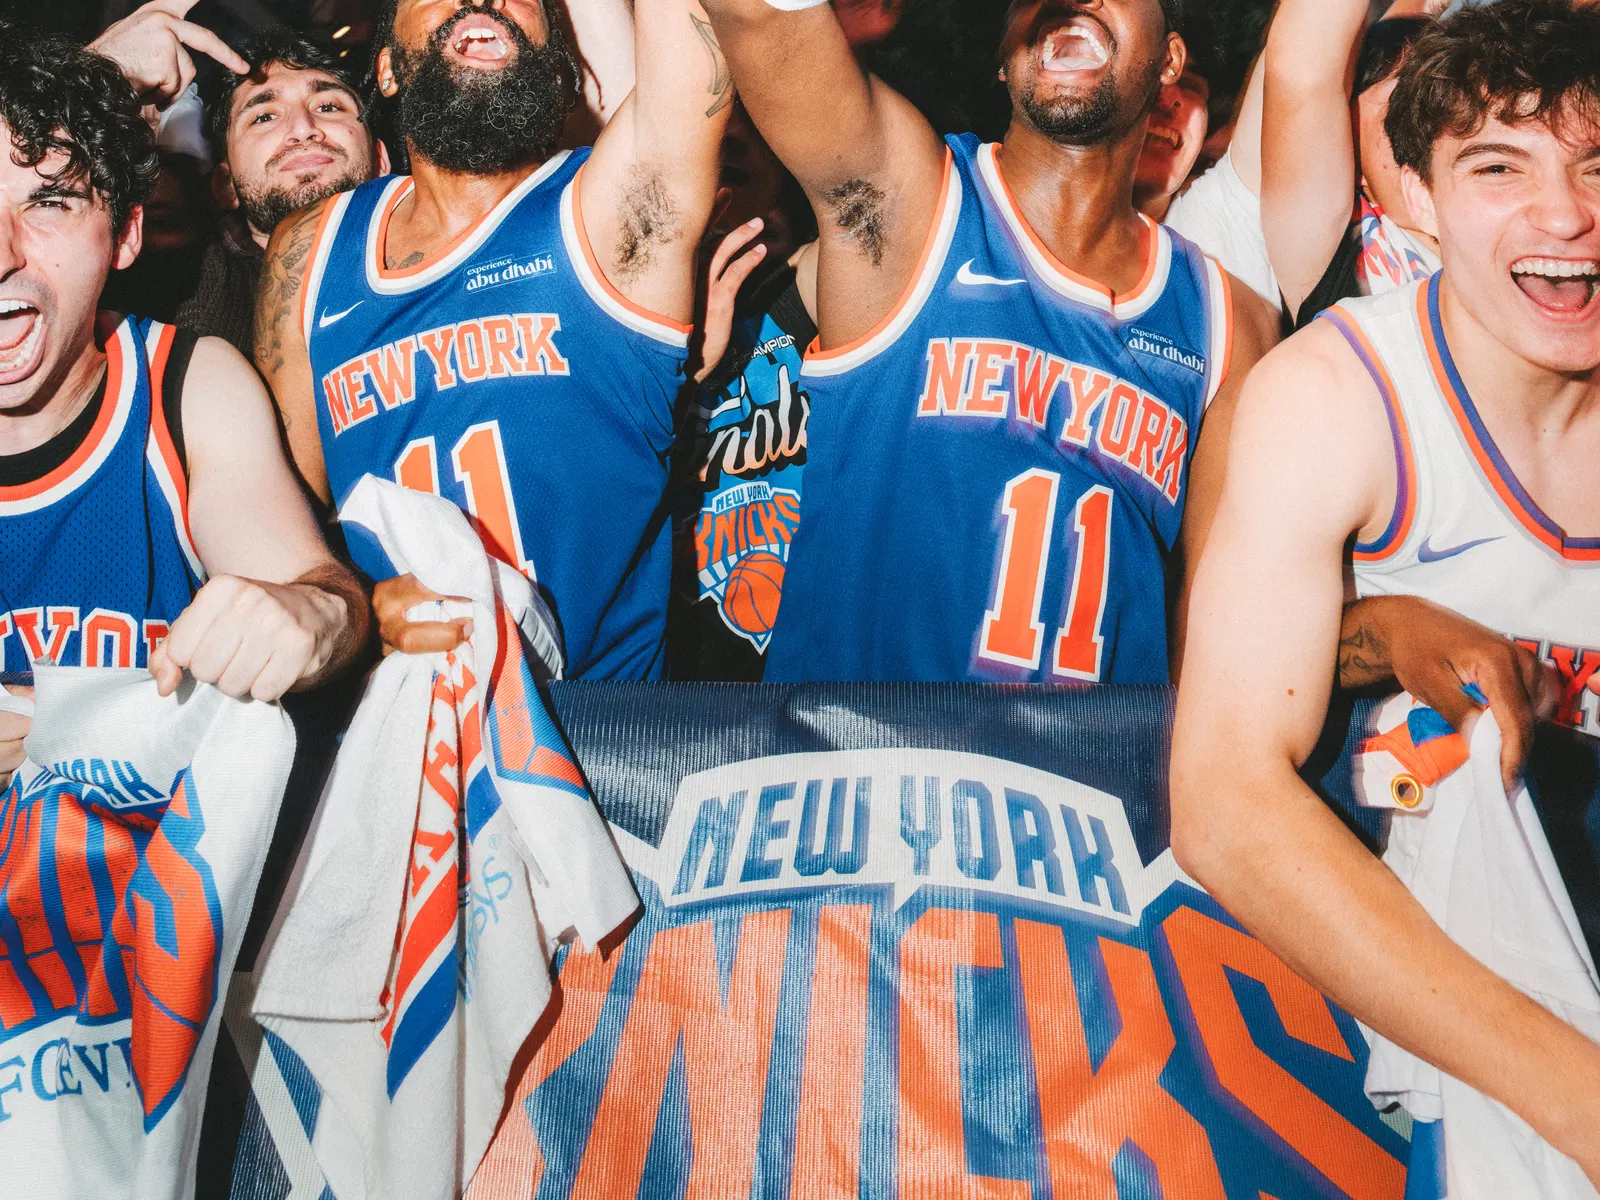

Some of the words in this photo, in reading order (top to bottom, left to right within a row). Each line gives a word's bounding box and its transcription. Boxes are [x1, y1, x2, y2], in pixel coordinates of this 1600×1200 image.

[466, 270, 500, 291] abu
[467, 258, 512, 276] experience
[1128, 337, 1160, 355] abu
[1130, 327, 1173, 345] experience
[322, 338, 418, 438] NEW
[418, 313, 570, 391] YORK
[917, 337, 1065, 430] NEW
[1060, 361, 1188, 506] YORK
[716, 488, 745, 512] NEW
[746, 484, 770, 502] YORK
[979, 467, 1113, 682] 11
[672, 777, 870, 895] NEW
[899, 774, 1131, 916] YORK
